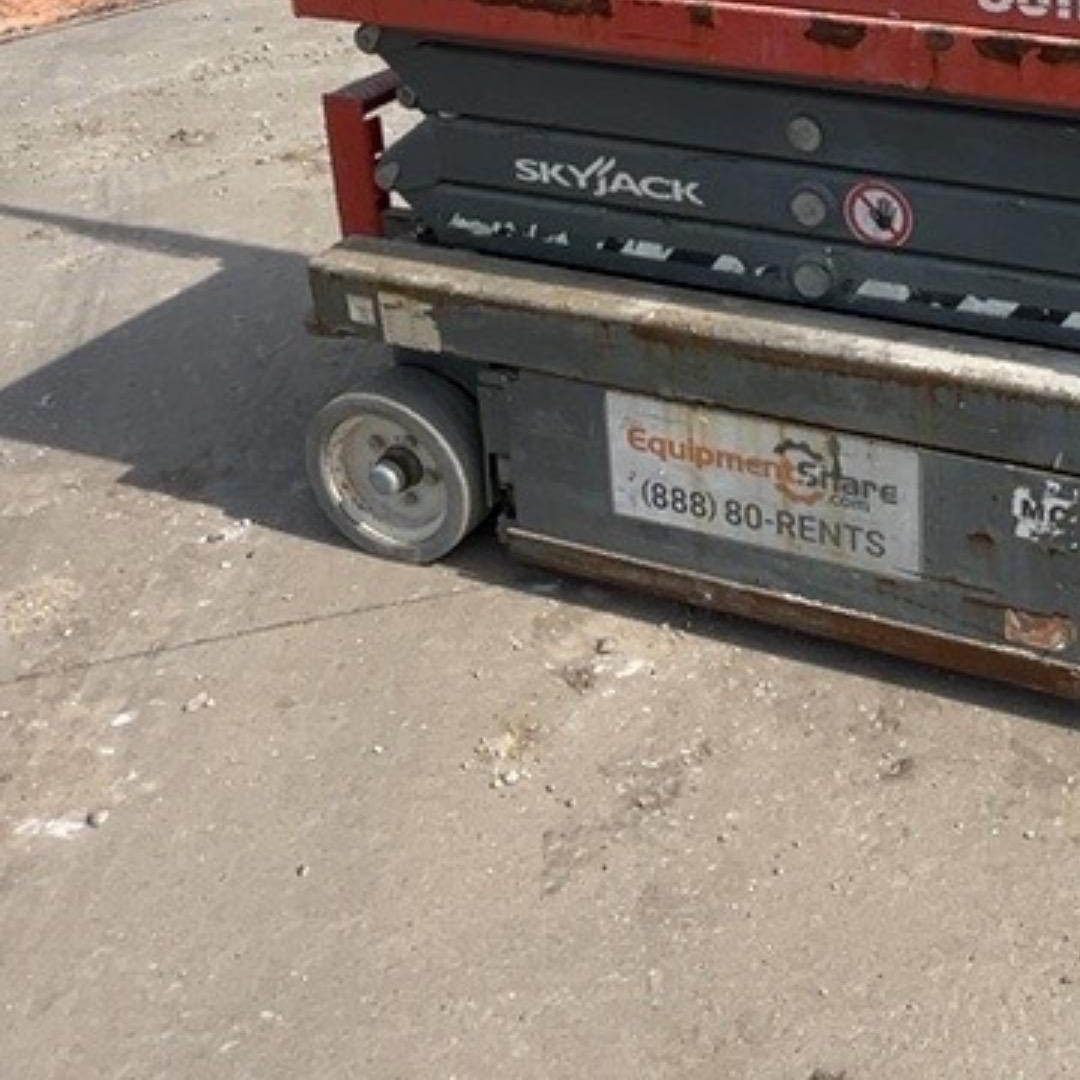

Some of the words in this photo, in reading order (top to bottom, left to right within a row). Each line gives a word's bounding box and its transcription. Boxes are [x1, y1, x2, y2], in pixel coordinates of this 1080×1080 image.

[514, 156, 703, 206] SKYJACK
[641, 478, 717, 522] (888)
[725, 498, 886, 560] 80-RENTS
